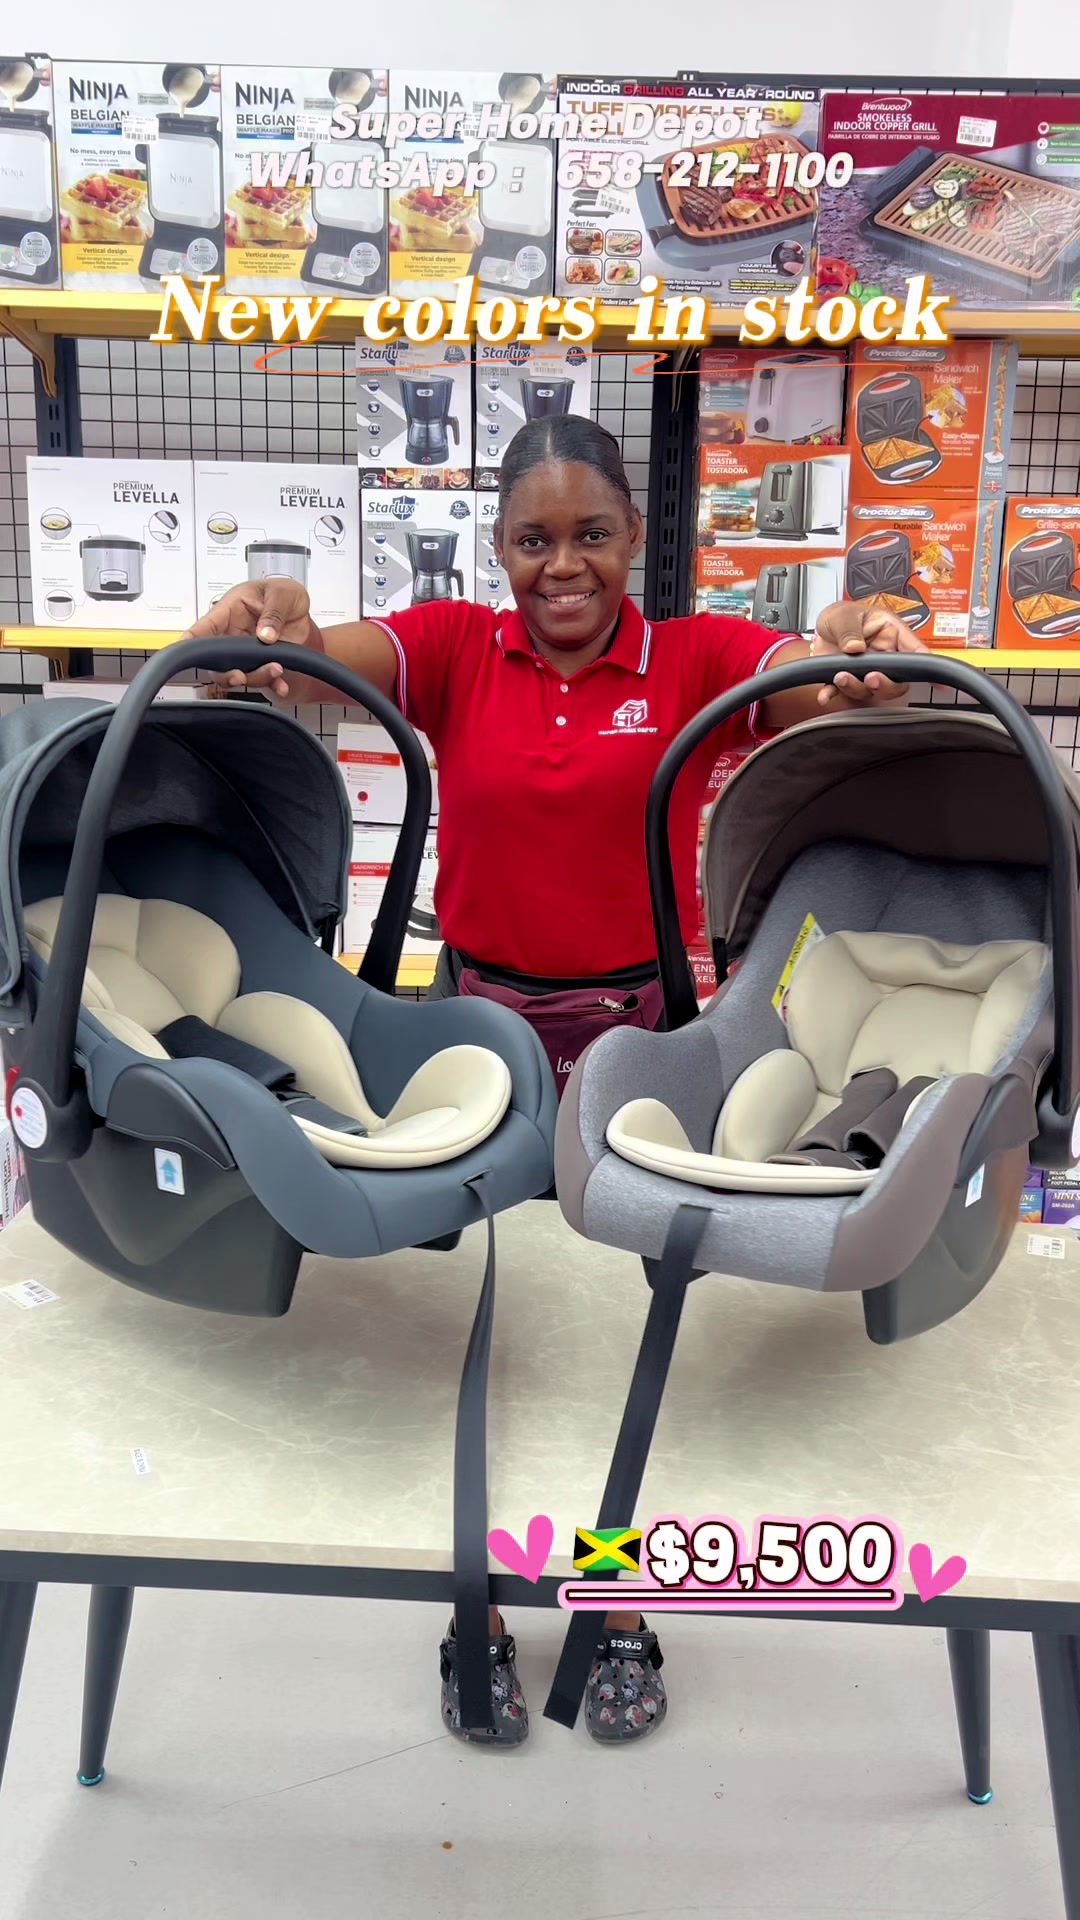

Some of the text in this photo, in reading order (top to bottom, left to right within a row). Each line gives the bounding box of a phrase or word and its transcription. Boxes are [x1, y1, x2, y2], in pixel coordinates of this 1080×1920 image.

[69, 77, 128, 107] NINJA
[567, 82, 620, 94] INDOOR
[623, 84, 684, 96] GRILLING
[687, 87, 713, 97] ALL
[235, 81, 295, 112] NINJA
[405, 84, 464, 113] NINJA
[861, 101, 907, 111] Brentwood
[237, 114, 296, 126] BELGIAN
[857, 113, 912, 122] SMOKELESS
[833, 121, 938, 131] INDOOR COPPER GRILL
[587, 220, 597, 228] For:
[360, 346, 398, 359] Starlu
[481, 345, 530, 360] Starlux
[869, 349, 939, 357] Proctor Silex
[934, 363, 979, 373] Sandwich
[933, 374, 963, 383] Maker
[942, 432, 980, 440] Easy-Clean
[707, 457, 738, 465] TOASTER
[113, 482, 153, 491] PREMIUM
[280, 487, 320, 495] PREMIUM
[113, 491, 180, 504] LEVELLA
[280, 495, 345, 508] LEVELLA
[368, 501, 415, 513] Starlux
[858, 508, 928, 516] Proctor Silex
[893, 521, 966, 531] Durable Sandwich
[922, 532, 951, 541] Maker
[611, 1639, 642, 1650] crocs
